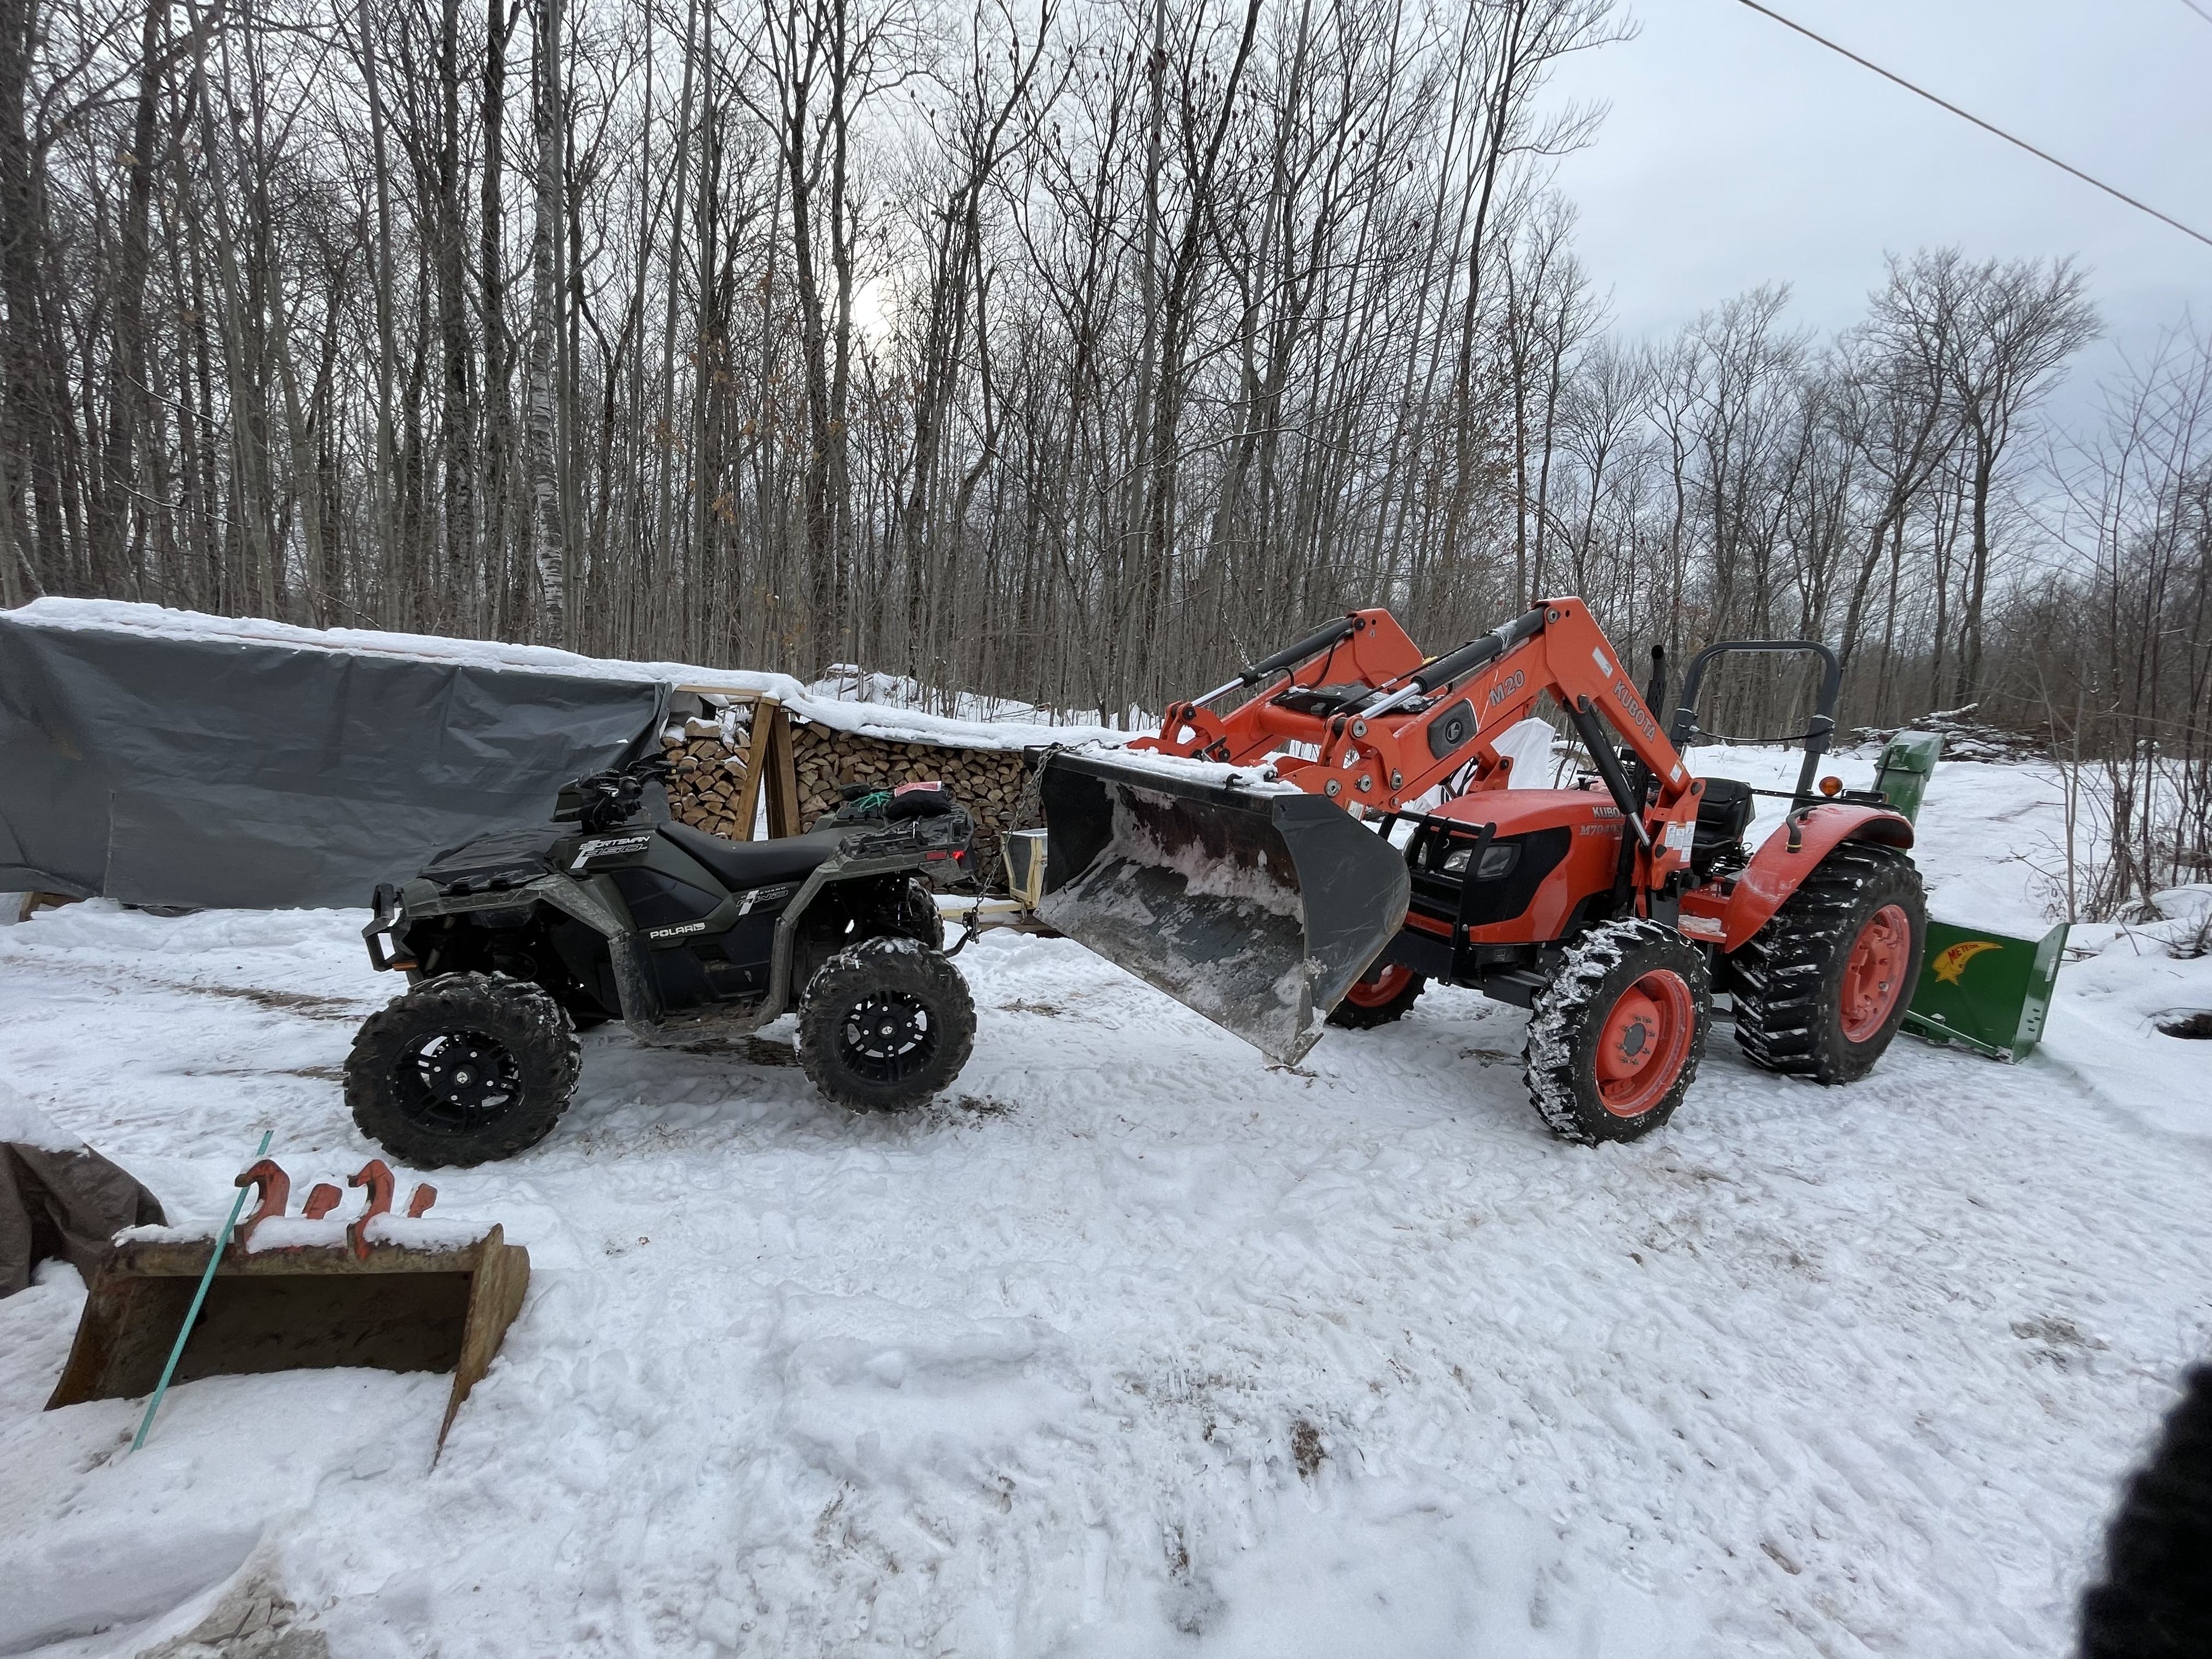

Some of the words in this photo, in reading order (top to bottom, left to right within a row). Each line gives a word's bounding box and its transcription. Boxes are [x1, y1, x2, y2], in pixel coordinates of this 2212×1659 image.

[1489, 669, 1525, 708] M20
[1613, 678, 1655, 743] KUBOTA
[1592, 806, 1624, 819] KUBO
[578, 836, 651, 850] SPORTSMAN
[735, 889, 789, 907] AWD
[650, 922, 706, 939] POLARIS
[1948, 944, 1979, 966] METEOR
